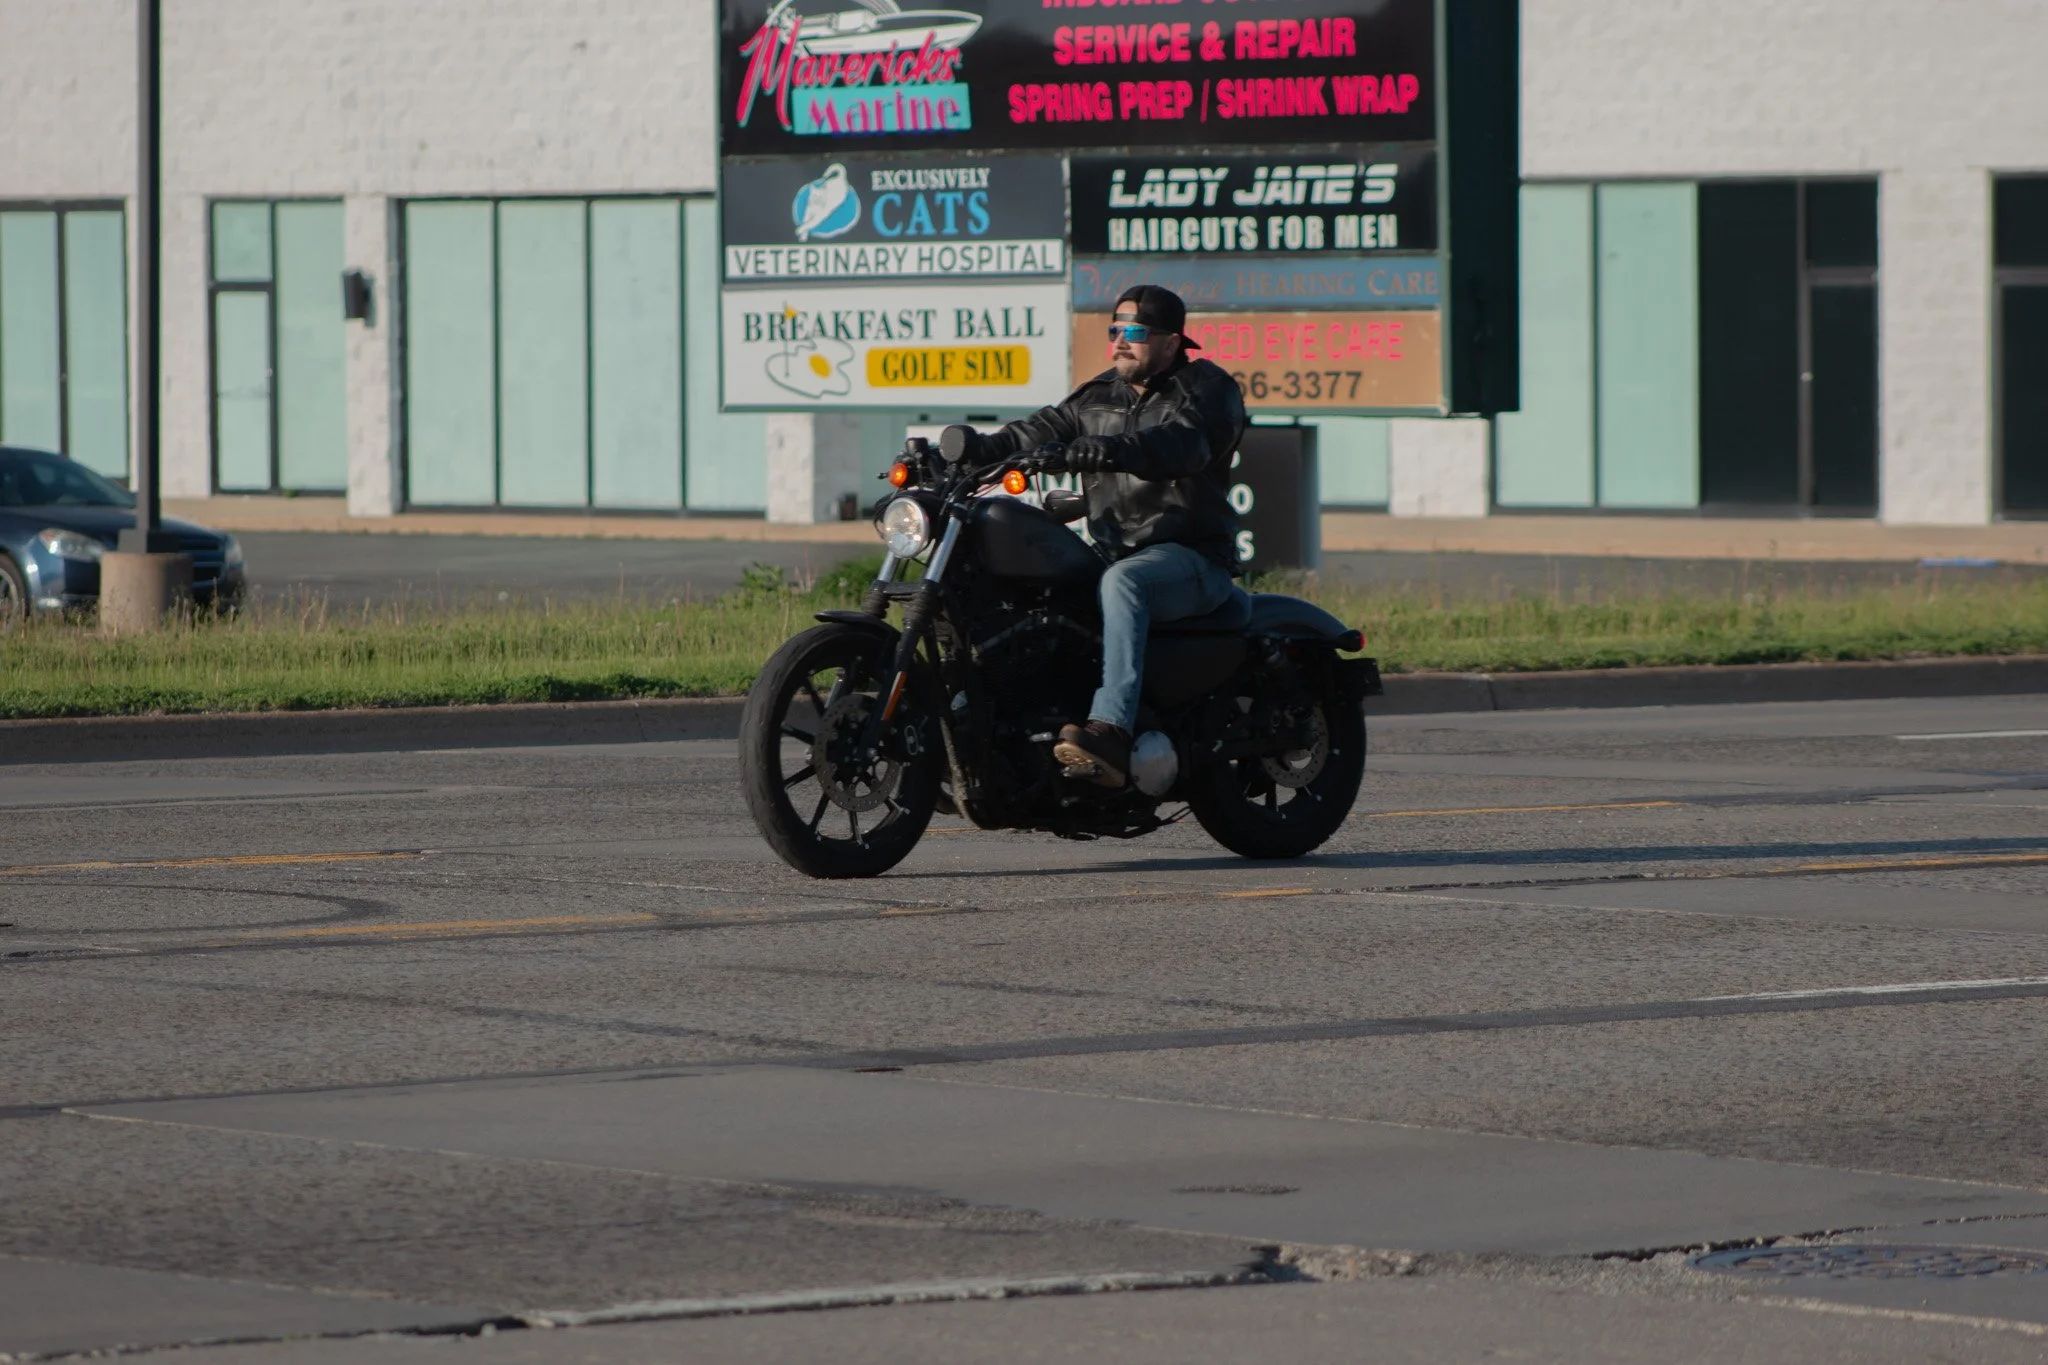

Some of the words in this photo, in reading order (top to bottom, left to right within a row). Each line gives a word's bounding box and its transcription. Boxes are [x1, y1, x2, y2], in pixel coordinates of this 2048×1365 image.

[1053, 22, 1191, 65] SERVICE
[1200, 20, 1226, 61] &
[1234, 17, 1357, 60] REPAIR
[737, 17, 962, 128] Mavericks
[807, 91, 961, 137] Marine
[1008, 81, 1111, 123] SPRING
[1119, 80, 1193, 121] PREP
[1216, 76, 1328, 119] SHRINK
[1333, 73, 1420, 116] WRAP
[870, 167, 991, 191] EXCLUSIVELY
[1109, 167, 1230, 208] LADY
[872, 191, 991, 238] CATS
[1108, 215, 1259, 251] HAIRCUTS
[1267, 214, 1325, 250] FOR
[1334, 213, 1399, 249] MEN
[734, 246, 908, 275] VETERINARY
[917, 242, 1055, 272] HOSPITAL
[1235, 270, 1357, 298] HEARING
[1367, 268, 1440, 296] CARE
[742, 307, 938, 343] BREAKFAST
[953, 306, 1045, 339] BALL
[1264, 323, 1319, 360] EYE
[1325, 321, 1406, 360] CARE
[881, 351, 957, 382] GOLF
[963, 349, 1014, 381] SIM
